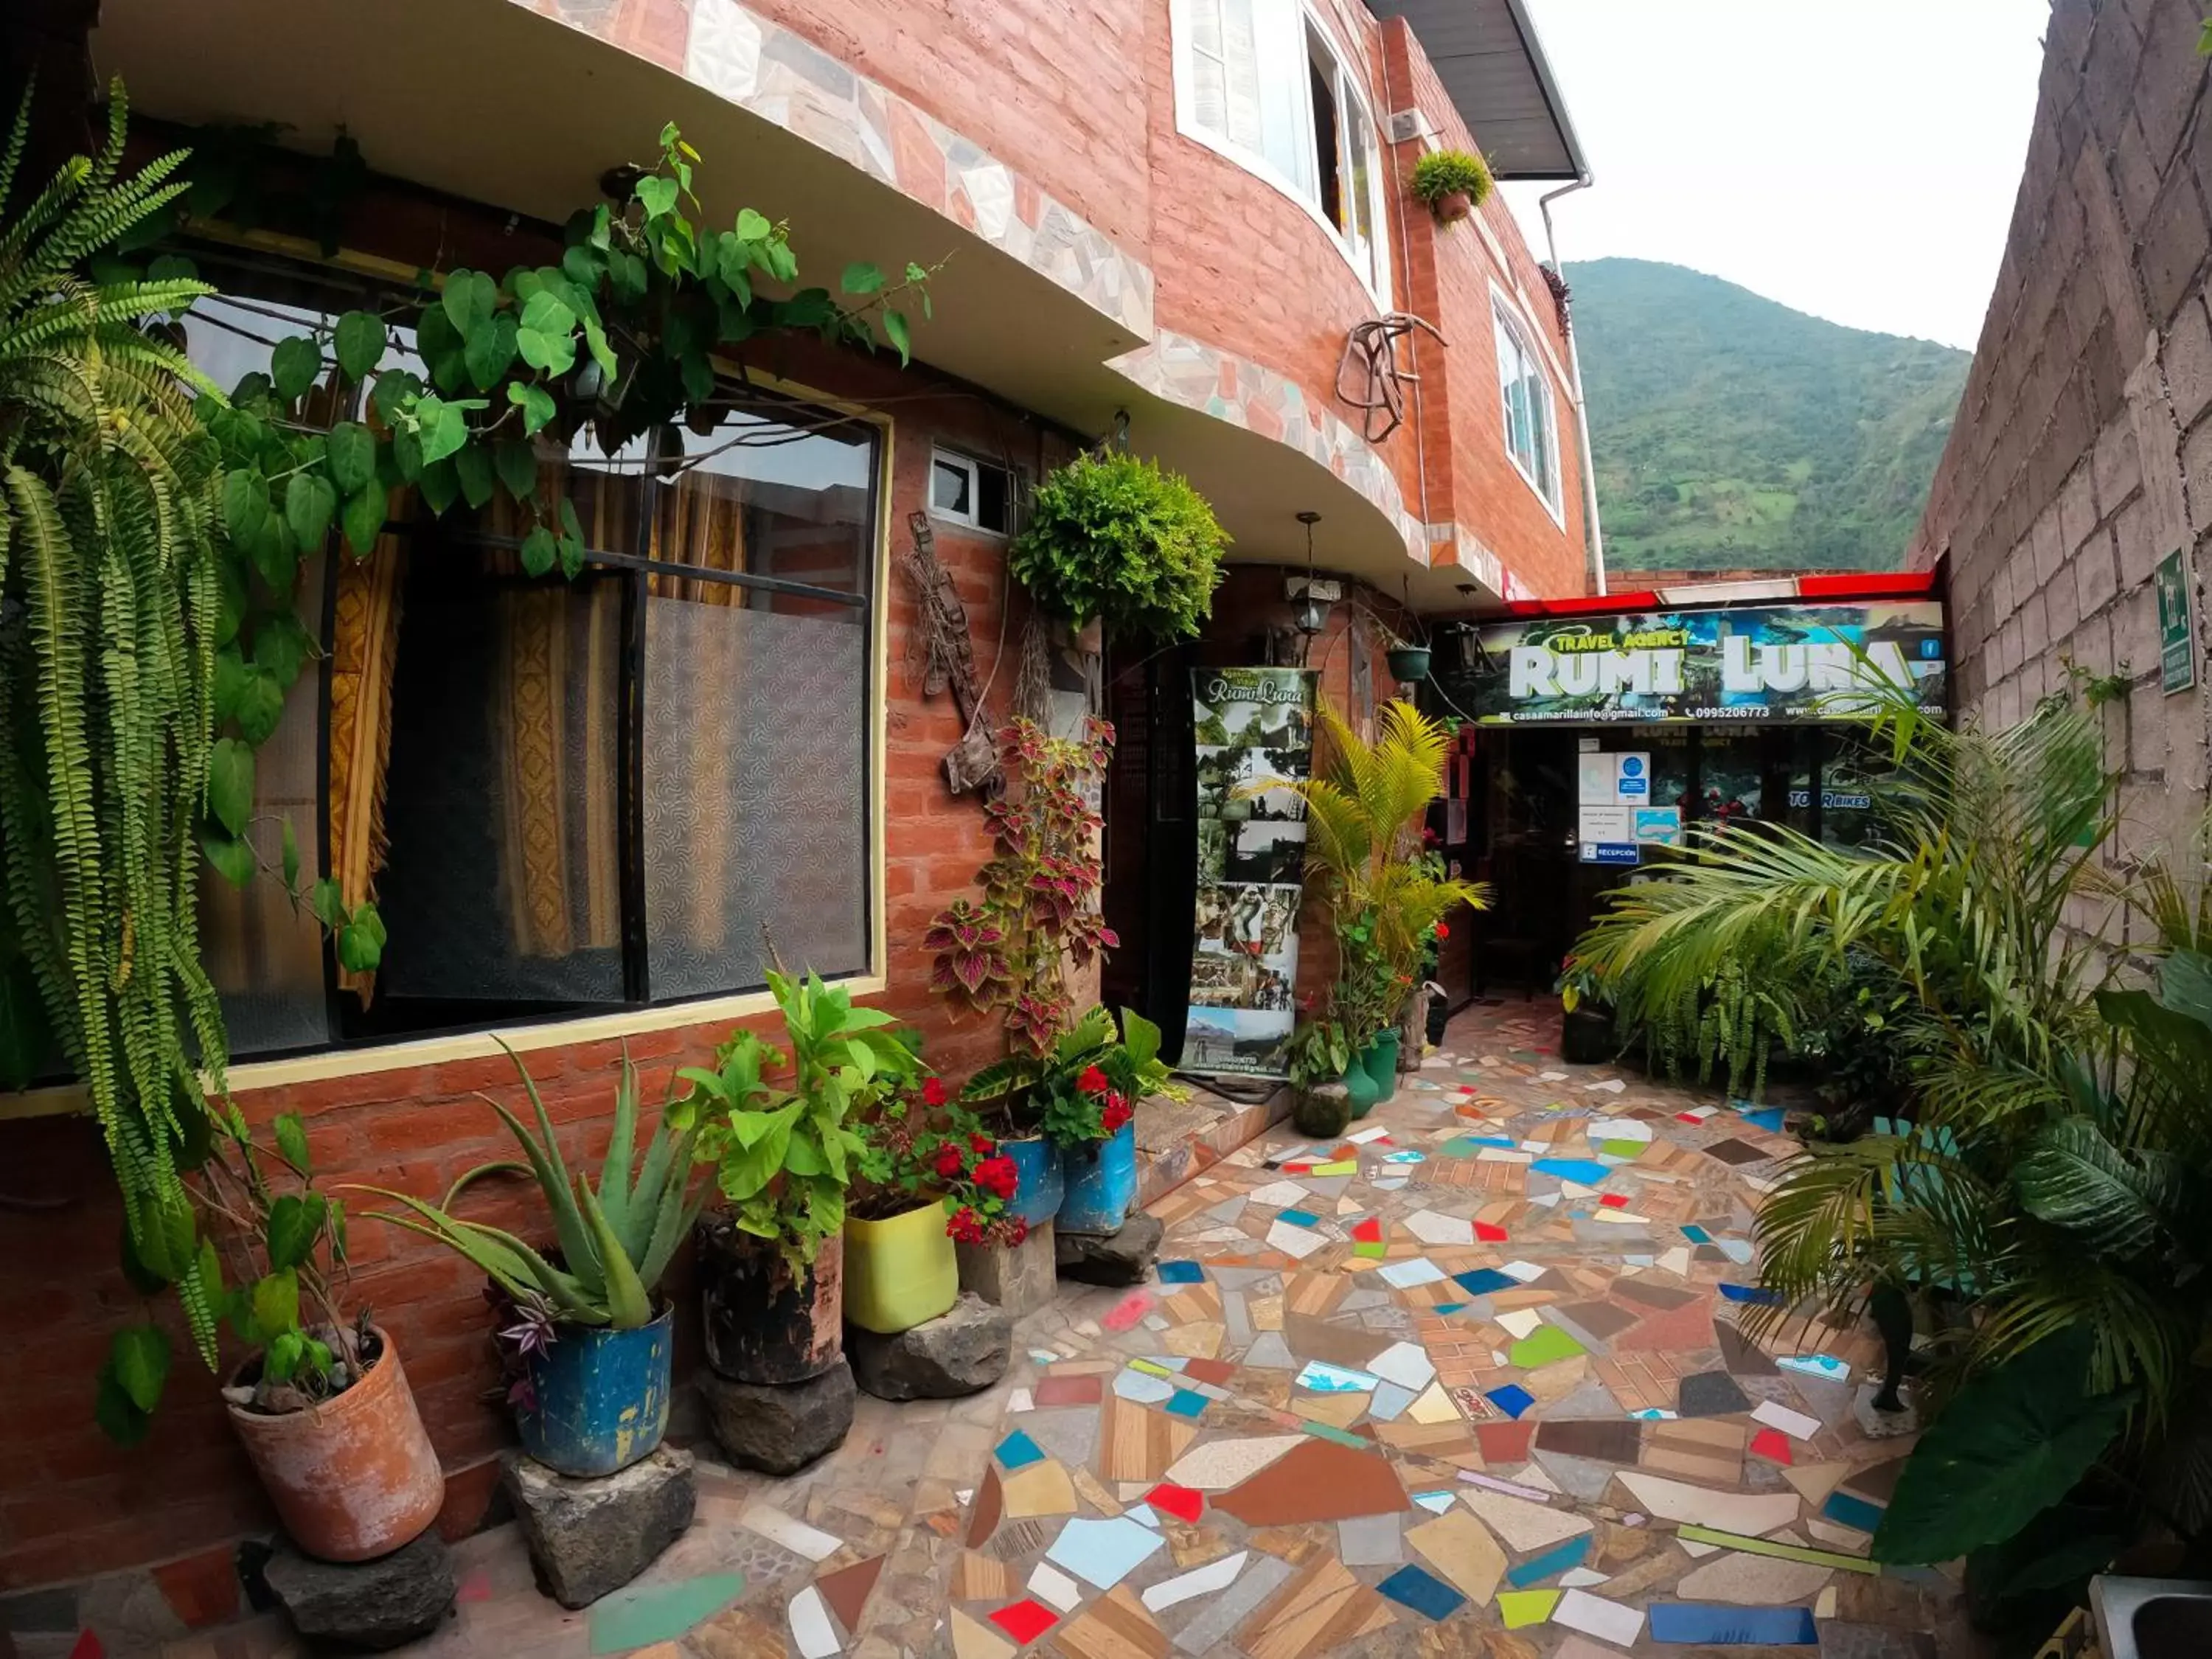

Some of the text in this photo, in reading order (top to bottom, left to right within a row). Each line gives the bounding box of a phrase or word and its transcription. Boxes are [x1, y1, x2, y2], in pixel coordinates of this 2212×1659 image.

[1557, 629, 1690, 650] TRAVEL AGENCY
[1509, 635, 1916, 697] RUMI LUNA
[1208, 678, 1302, 704] Rumi Luna
[1695, 707, 1770, 719] 0995206773
[1834, 795, 1871, 809] BIKES
